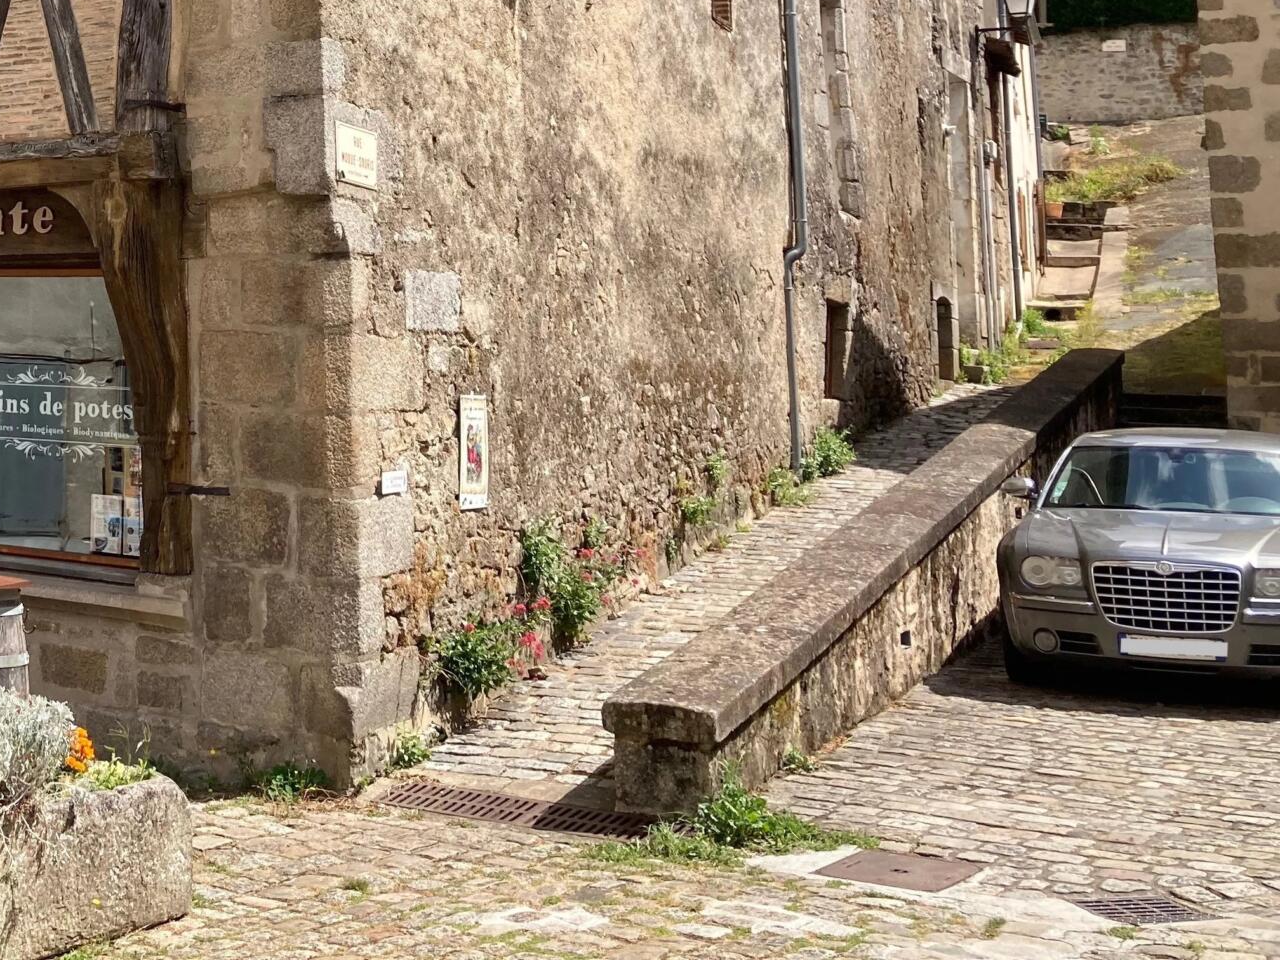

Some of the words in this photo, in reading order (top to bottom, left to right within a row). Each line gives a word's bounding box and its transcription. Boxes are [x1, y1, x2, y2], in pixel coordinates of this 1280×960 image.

[39, 391, 64, 417] de
[73, 399, 134, 424] potes
[22, 423, 64, 436] Biologiques
